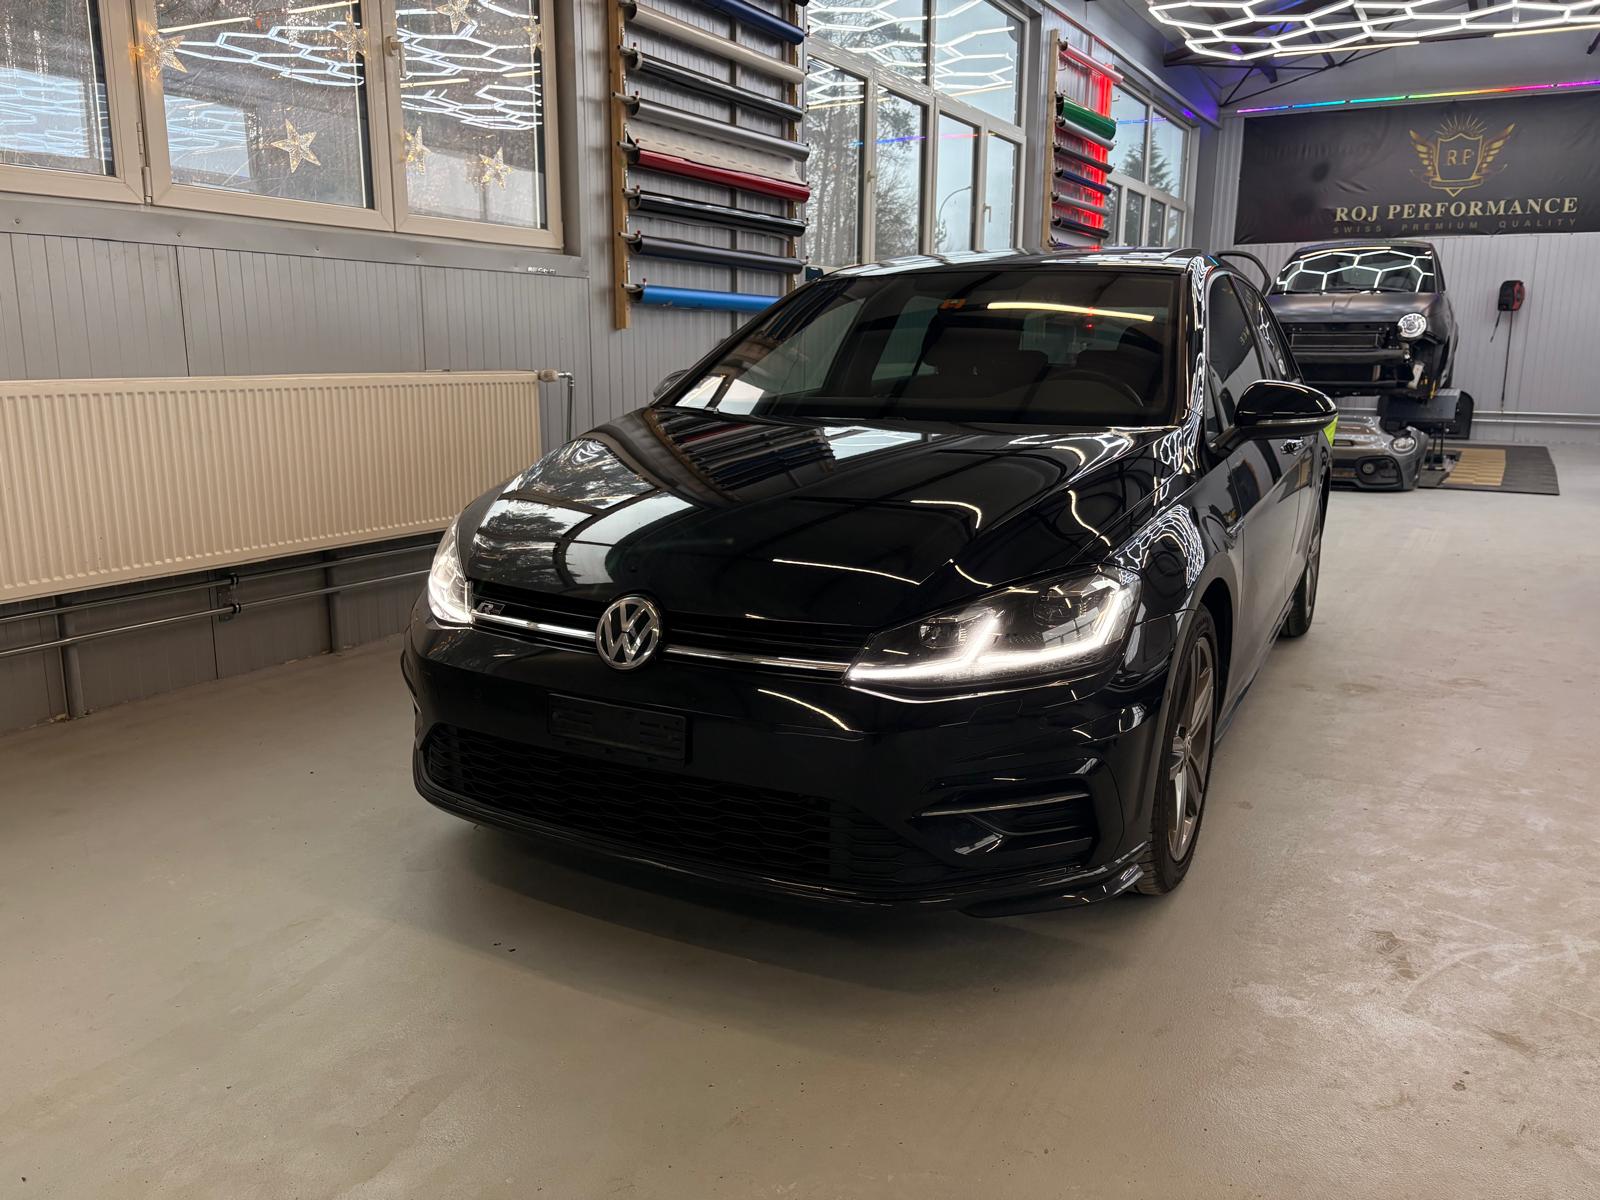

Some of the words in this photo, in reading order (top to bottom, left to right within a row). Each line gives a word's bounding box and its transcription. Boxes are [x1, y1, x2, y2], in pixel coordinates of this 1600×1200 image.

[1335, 205, 1379, 222] ROJ
[1387, 197, 1578, 220] PERFORMANCE
[1333, 225, 1382, 234] SWISS
[1401, 221, 1478, 231] PREMIUM
[1499, 218, 1576, 229] QUALITY
